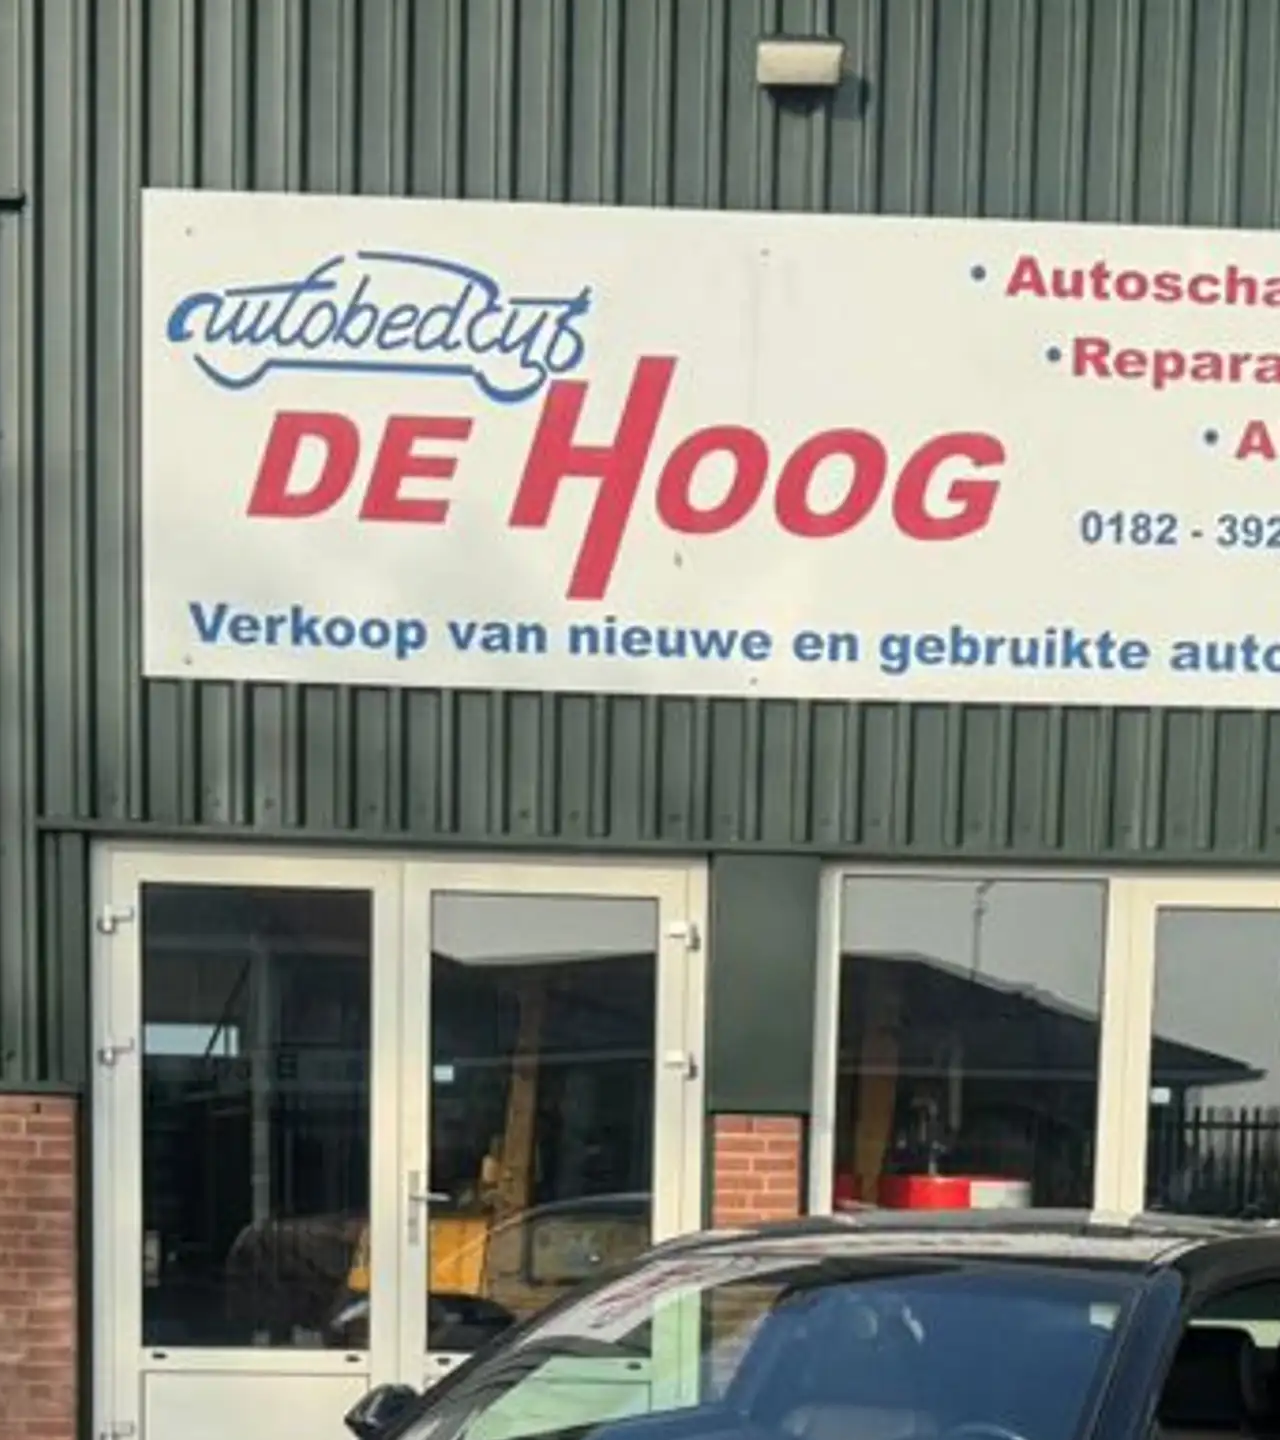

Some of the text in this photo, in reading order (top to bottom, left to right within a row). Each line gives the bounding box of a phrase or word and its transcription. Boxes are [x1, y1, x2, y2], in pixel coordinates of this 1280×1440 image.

[246, 355, 1006, 601] DE HOOG
[1080, 510, 1179, 547] 0182
[187, 601, 428, 660] Verkoop
[448, 622, 548, 656] van
[568, 616, 773, 662] nieuwe
[793, 629, 859, 663] en
[879, 625, 1151, 673] gebruikte
